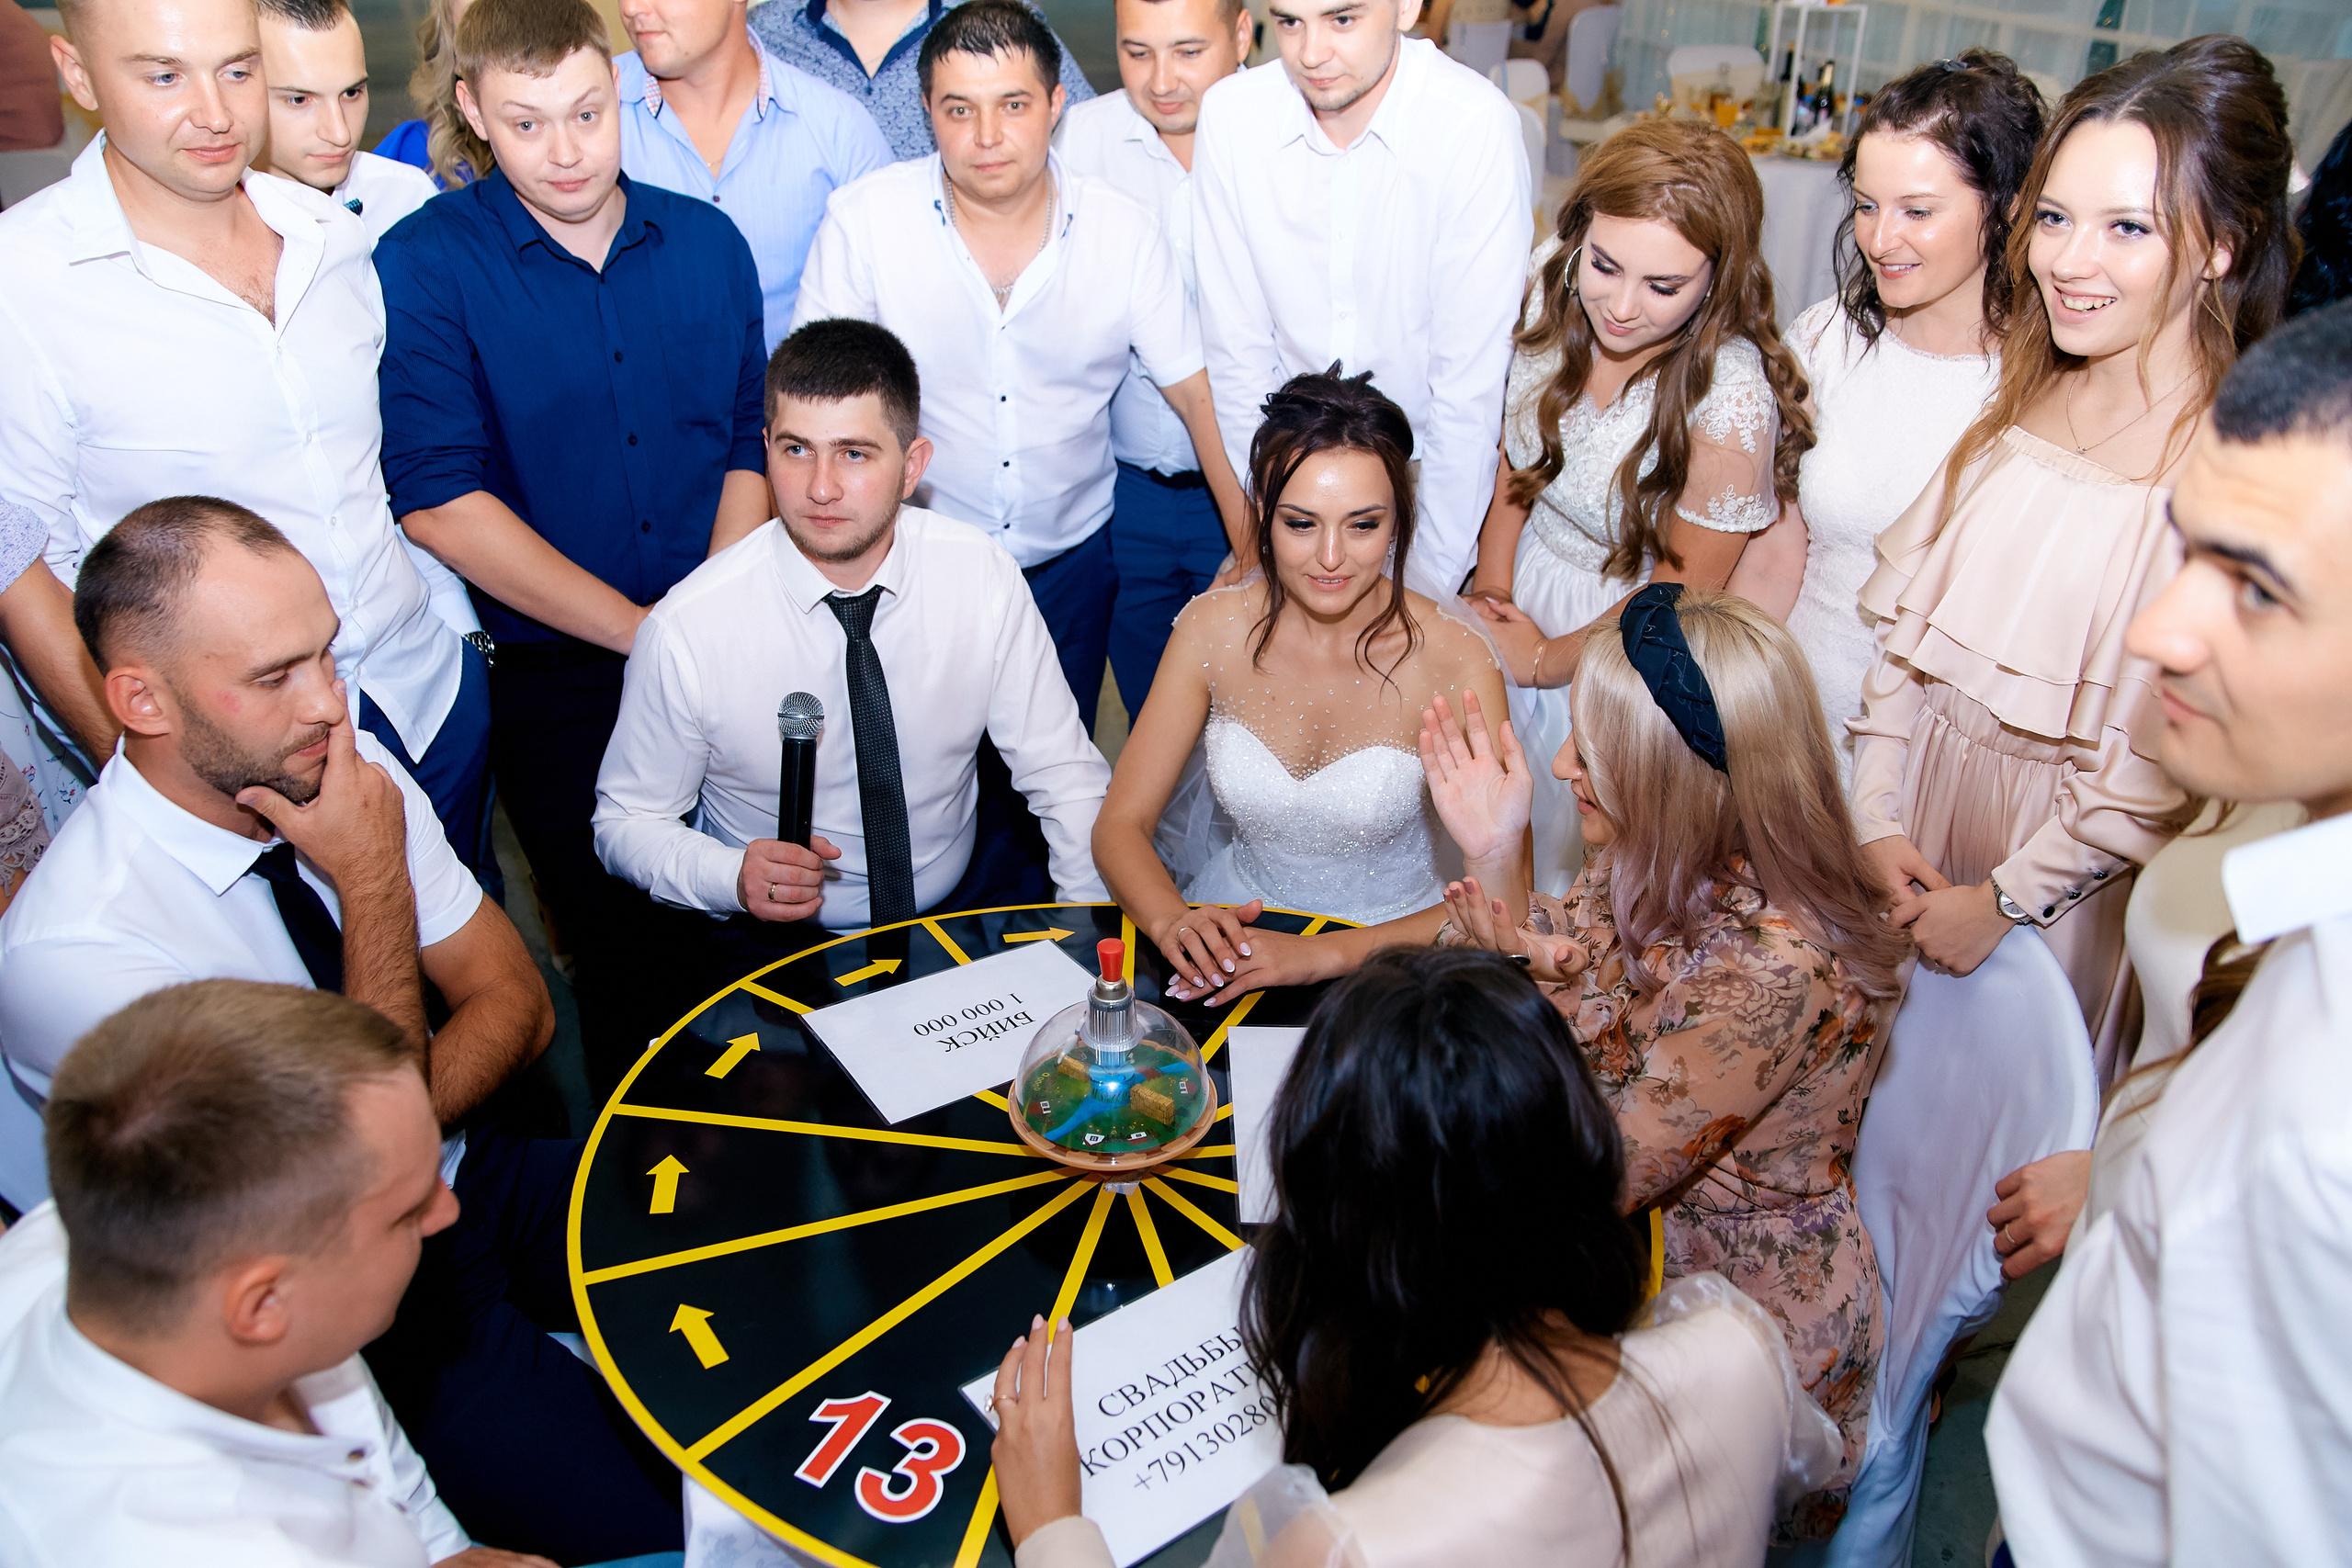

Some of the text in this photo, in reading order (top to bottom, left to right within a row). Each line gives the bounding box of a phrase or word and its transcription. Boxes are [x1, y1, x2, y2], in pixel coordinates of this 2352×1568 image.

[913, 992, 1024, 1036] 1 000 000
[936, 1010, 1035, 1052] БИЙСК
[794, 1390, 967, 1524] 13
